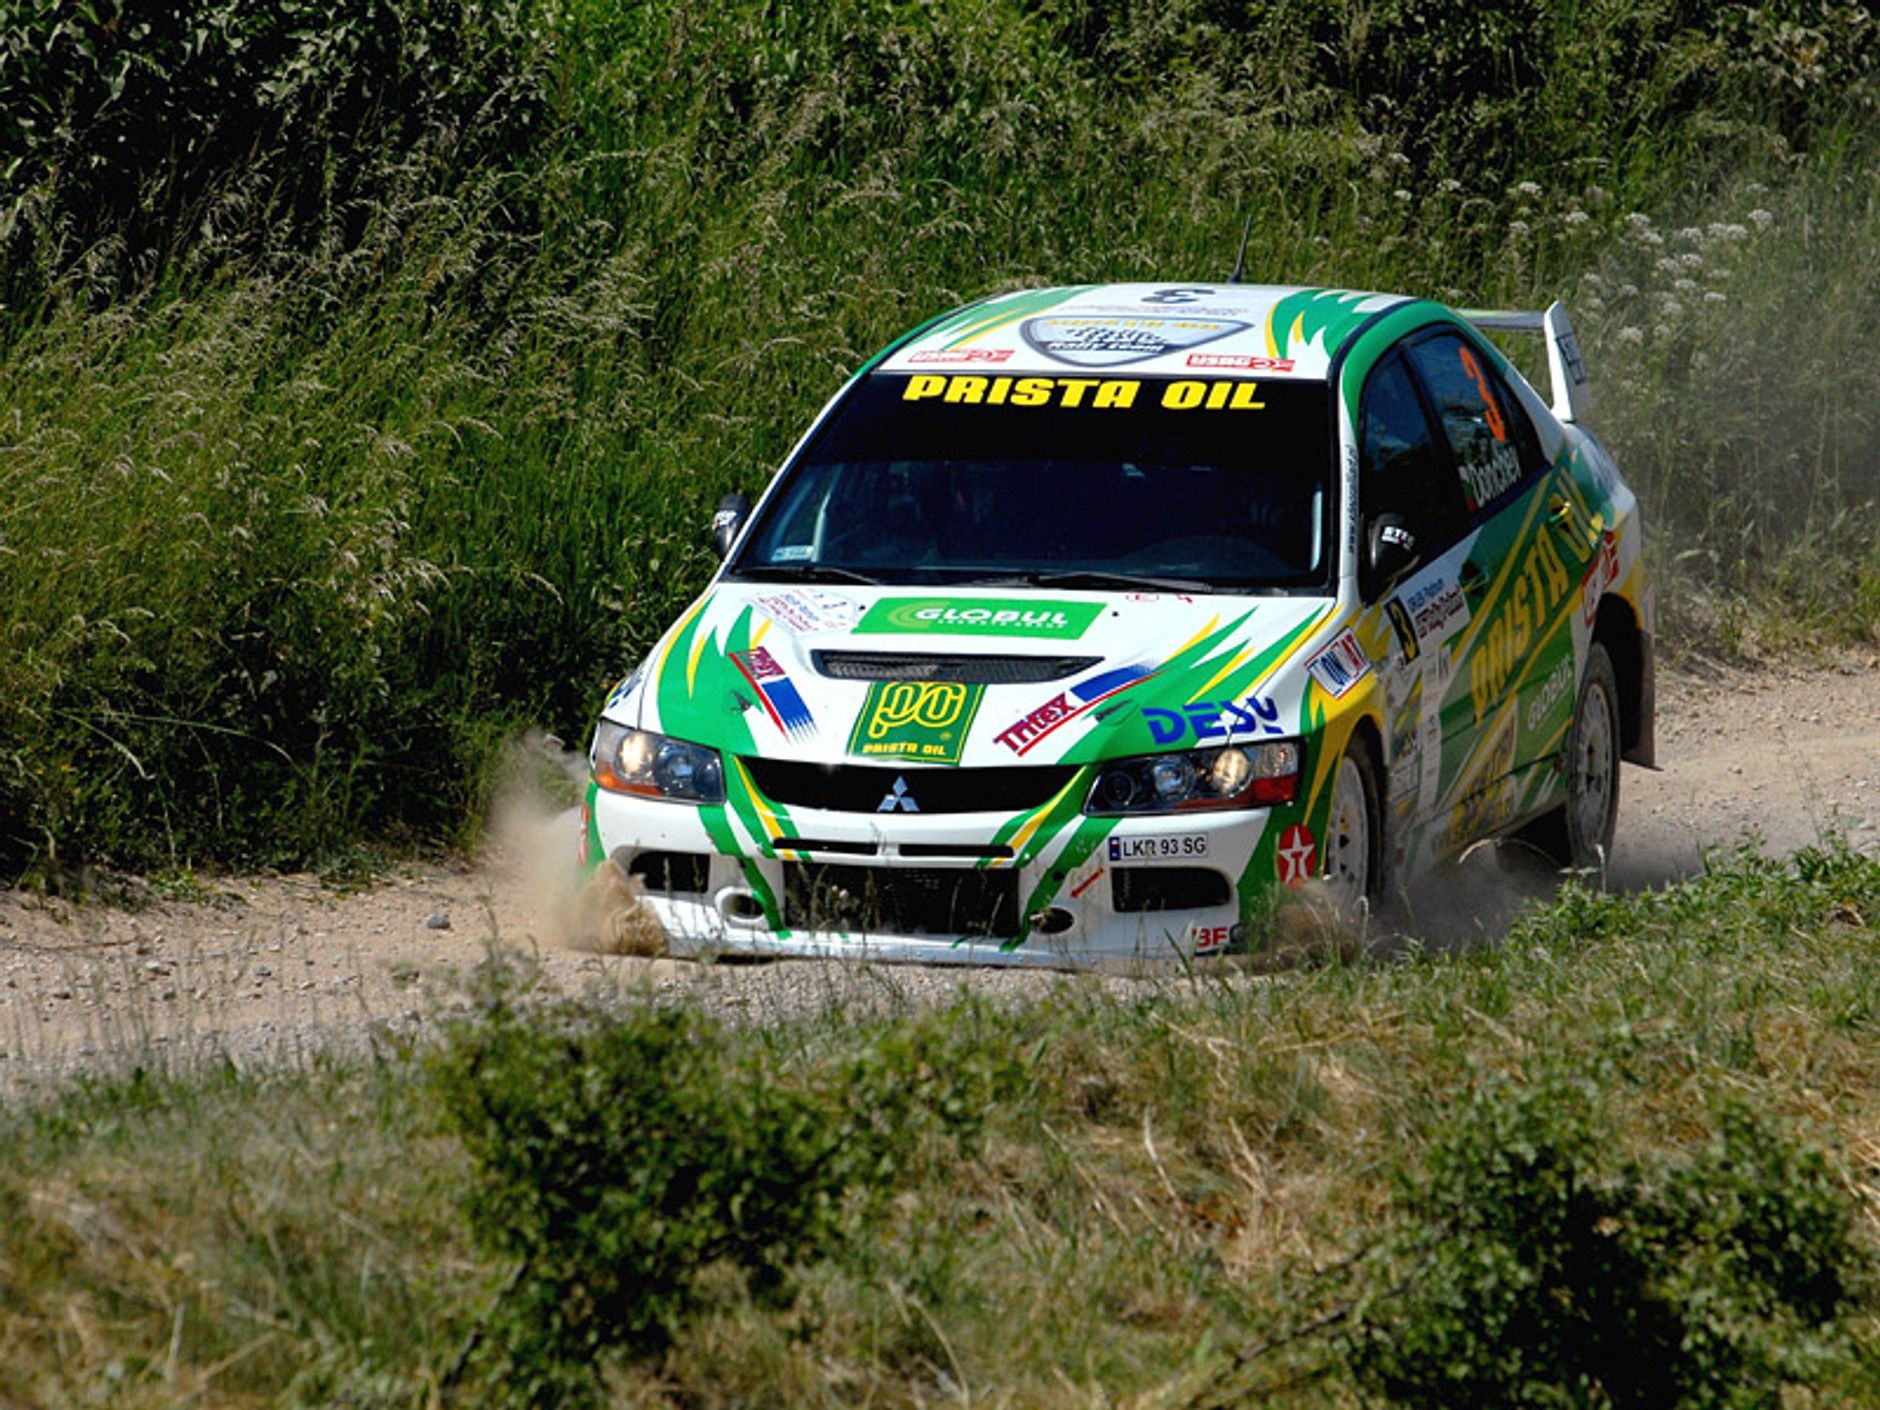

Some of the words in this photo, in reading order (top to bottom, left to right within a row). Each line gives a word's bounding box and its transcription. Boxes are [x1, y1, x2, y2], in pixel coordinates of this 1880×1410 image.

[902, 374, 1141, 409] PRISTA
[1161, 380, 1266, 409] OIL
[1458, 347, 1506, 442] 3
[915, 608, 1068, 626] GLOBUL
[1389, 602, 1416, 660] 3
[1471, 524, 1570, 728] PRISTA
[862, 742, 919, 755] PRISTA
[922, 743, 947, 756] OIL
[1122, 839, 1156, 858] LKR
[1160, 838, 1179, 855] 93
[1182, 836, 1207, 855] SG
